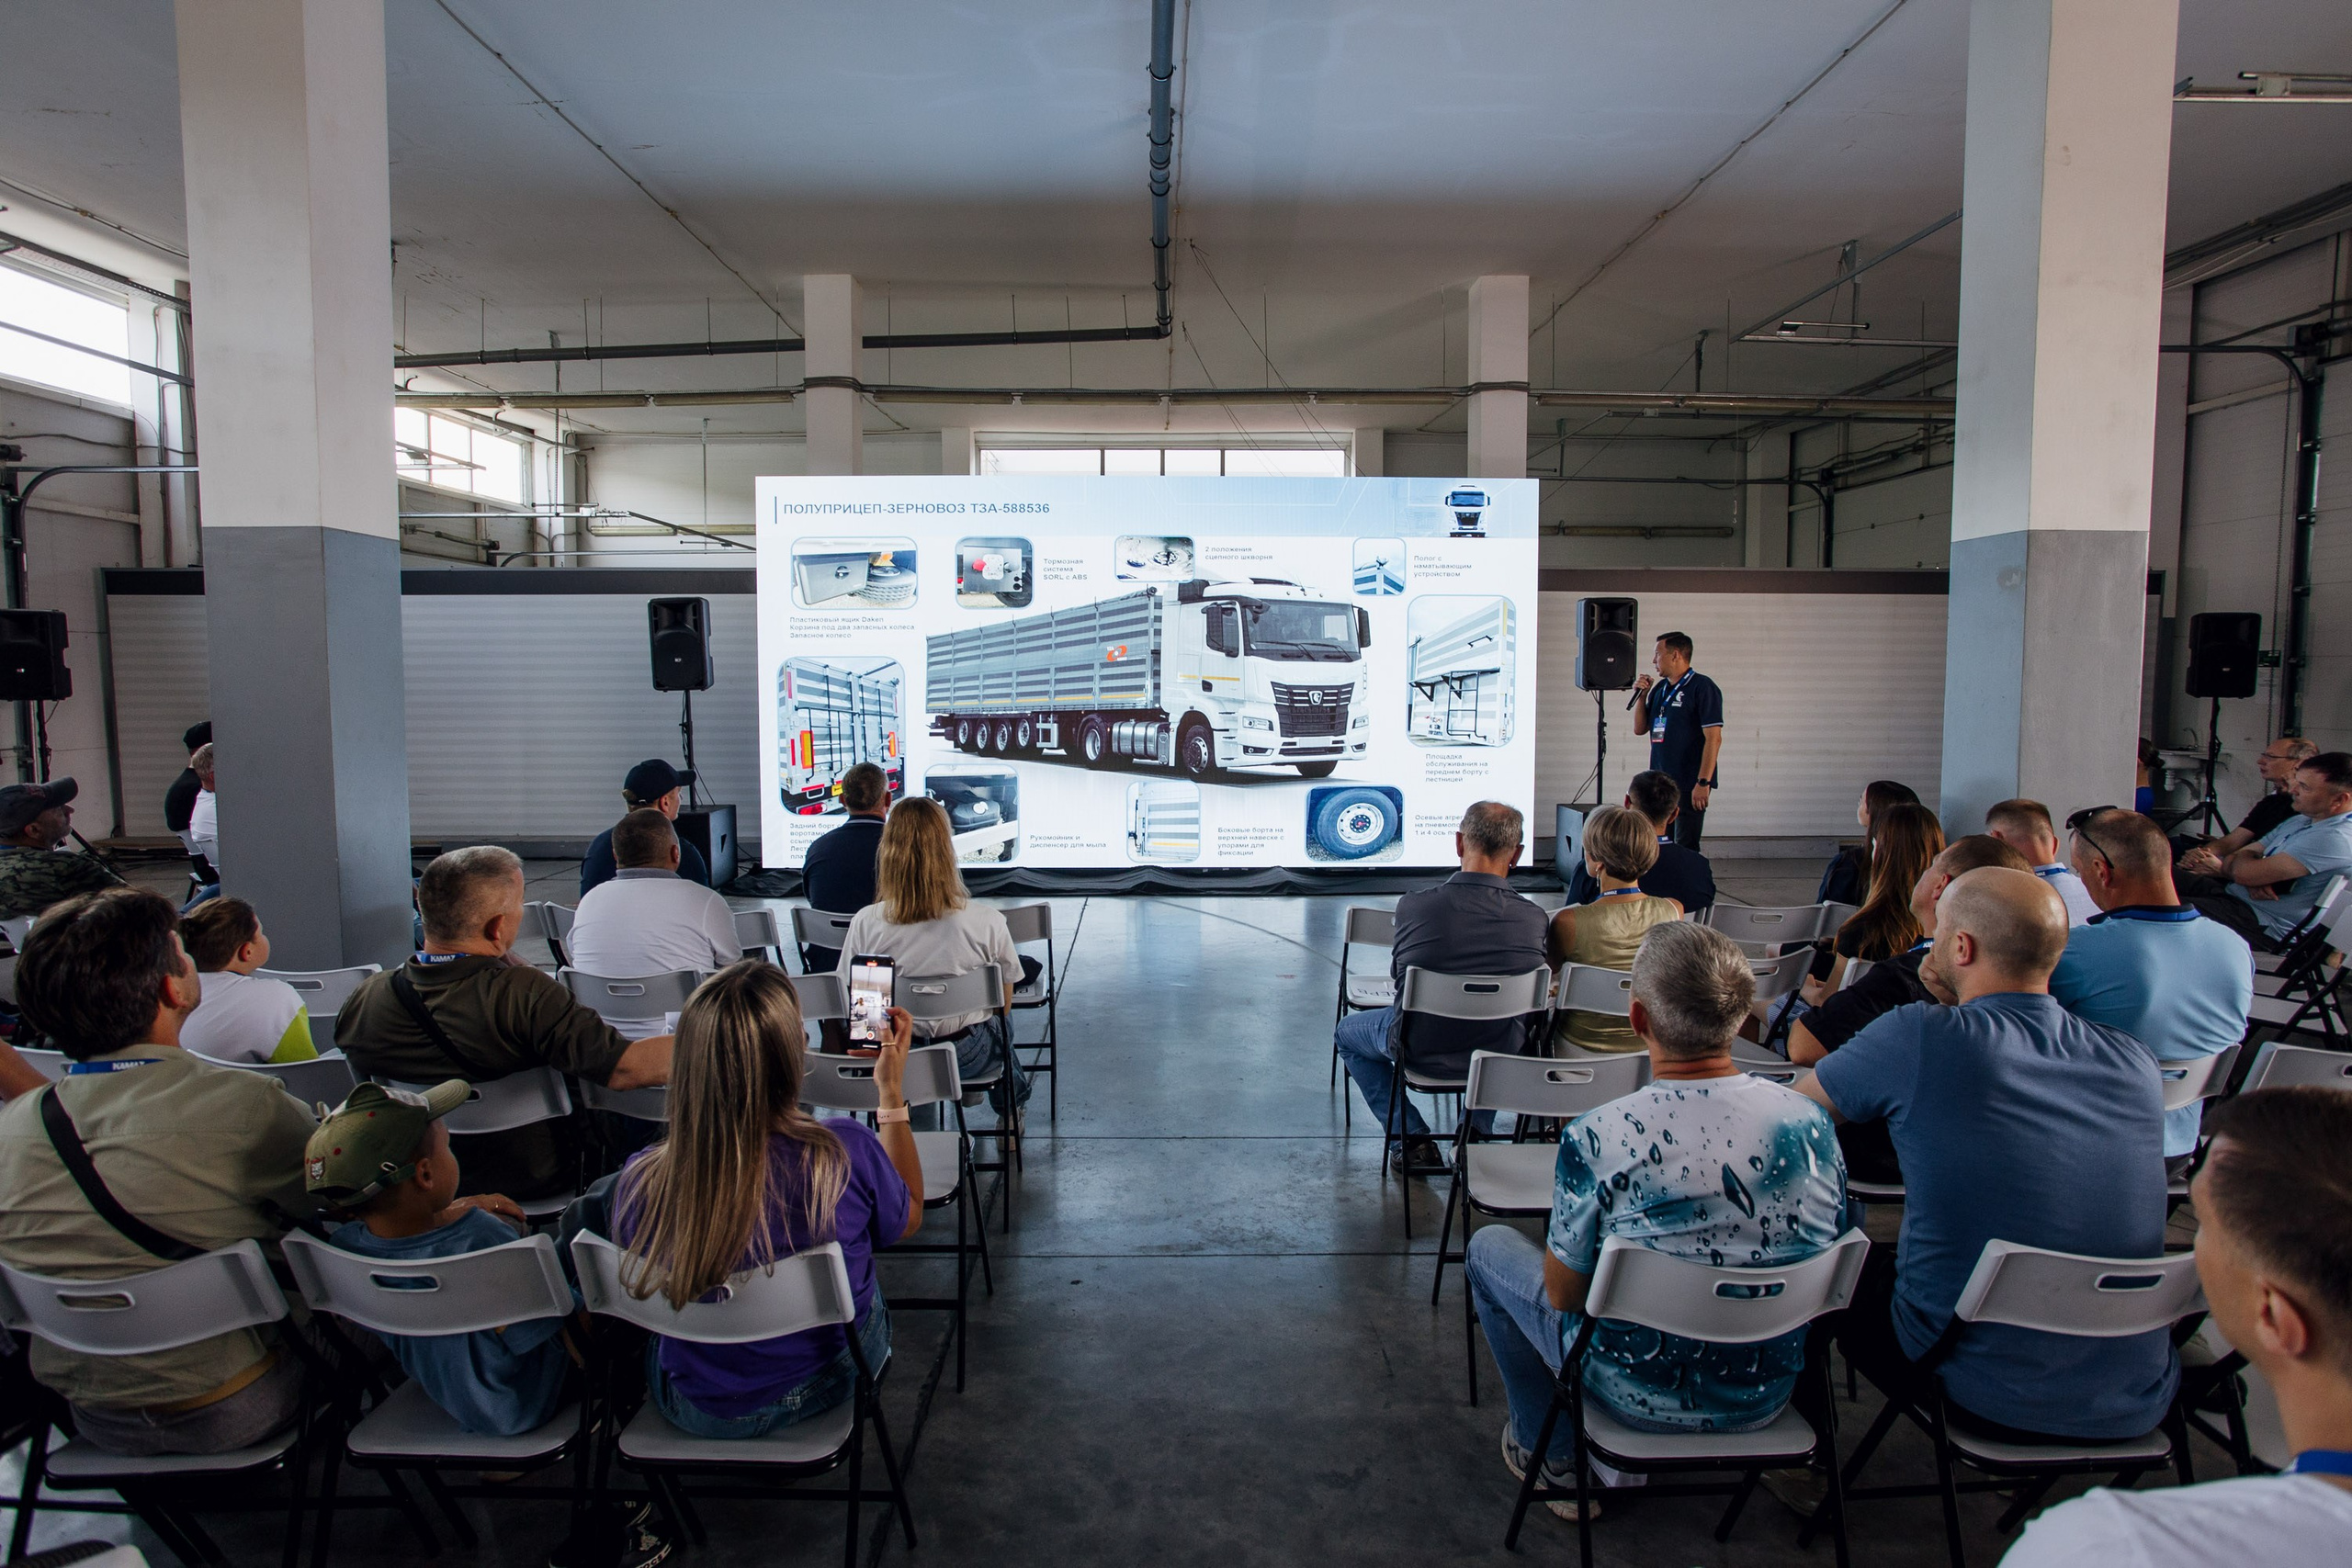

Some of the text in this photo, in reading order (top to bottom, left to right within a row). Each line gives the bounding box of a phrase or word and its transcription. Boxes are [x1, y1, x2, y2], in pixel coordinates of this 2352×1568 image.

[784, 503, 1050, 515] ПОЛУПРИЦЕП-ЗЕРНОВОЗ ТЗА-588536
[1043, 558, 1084, 566] Тормозная
